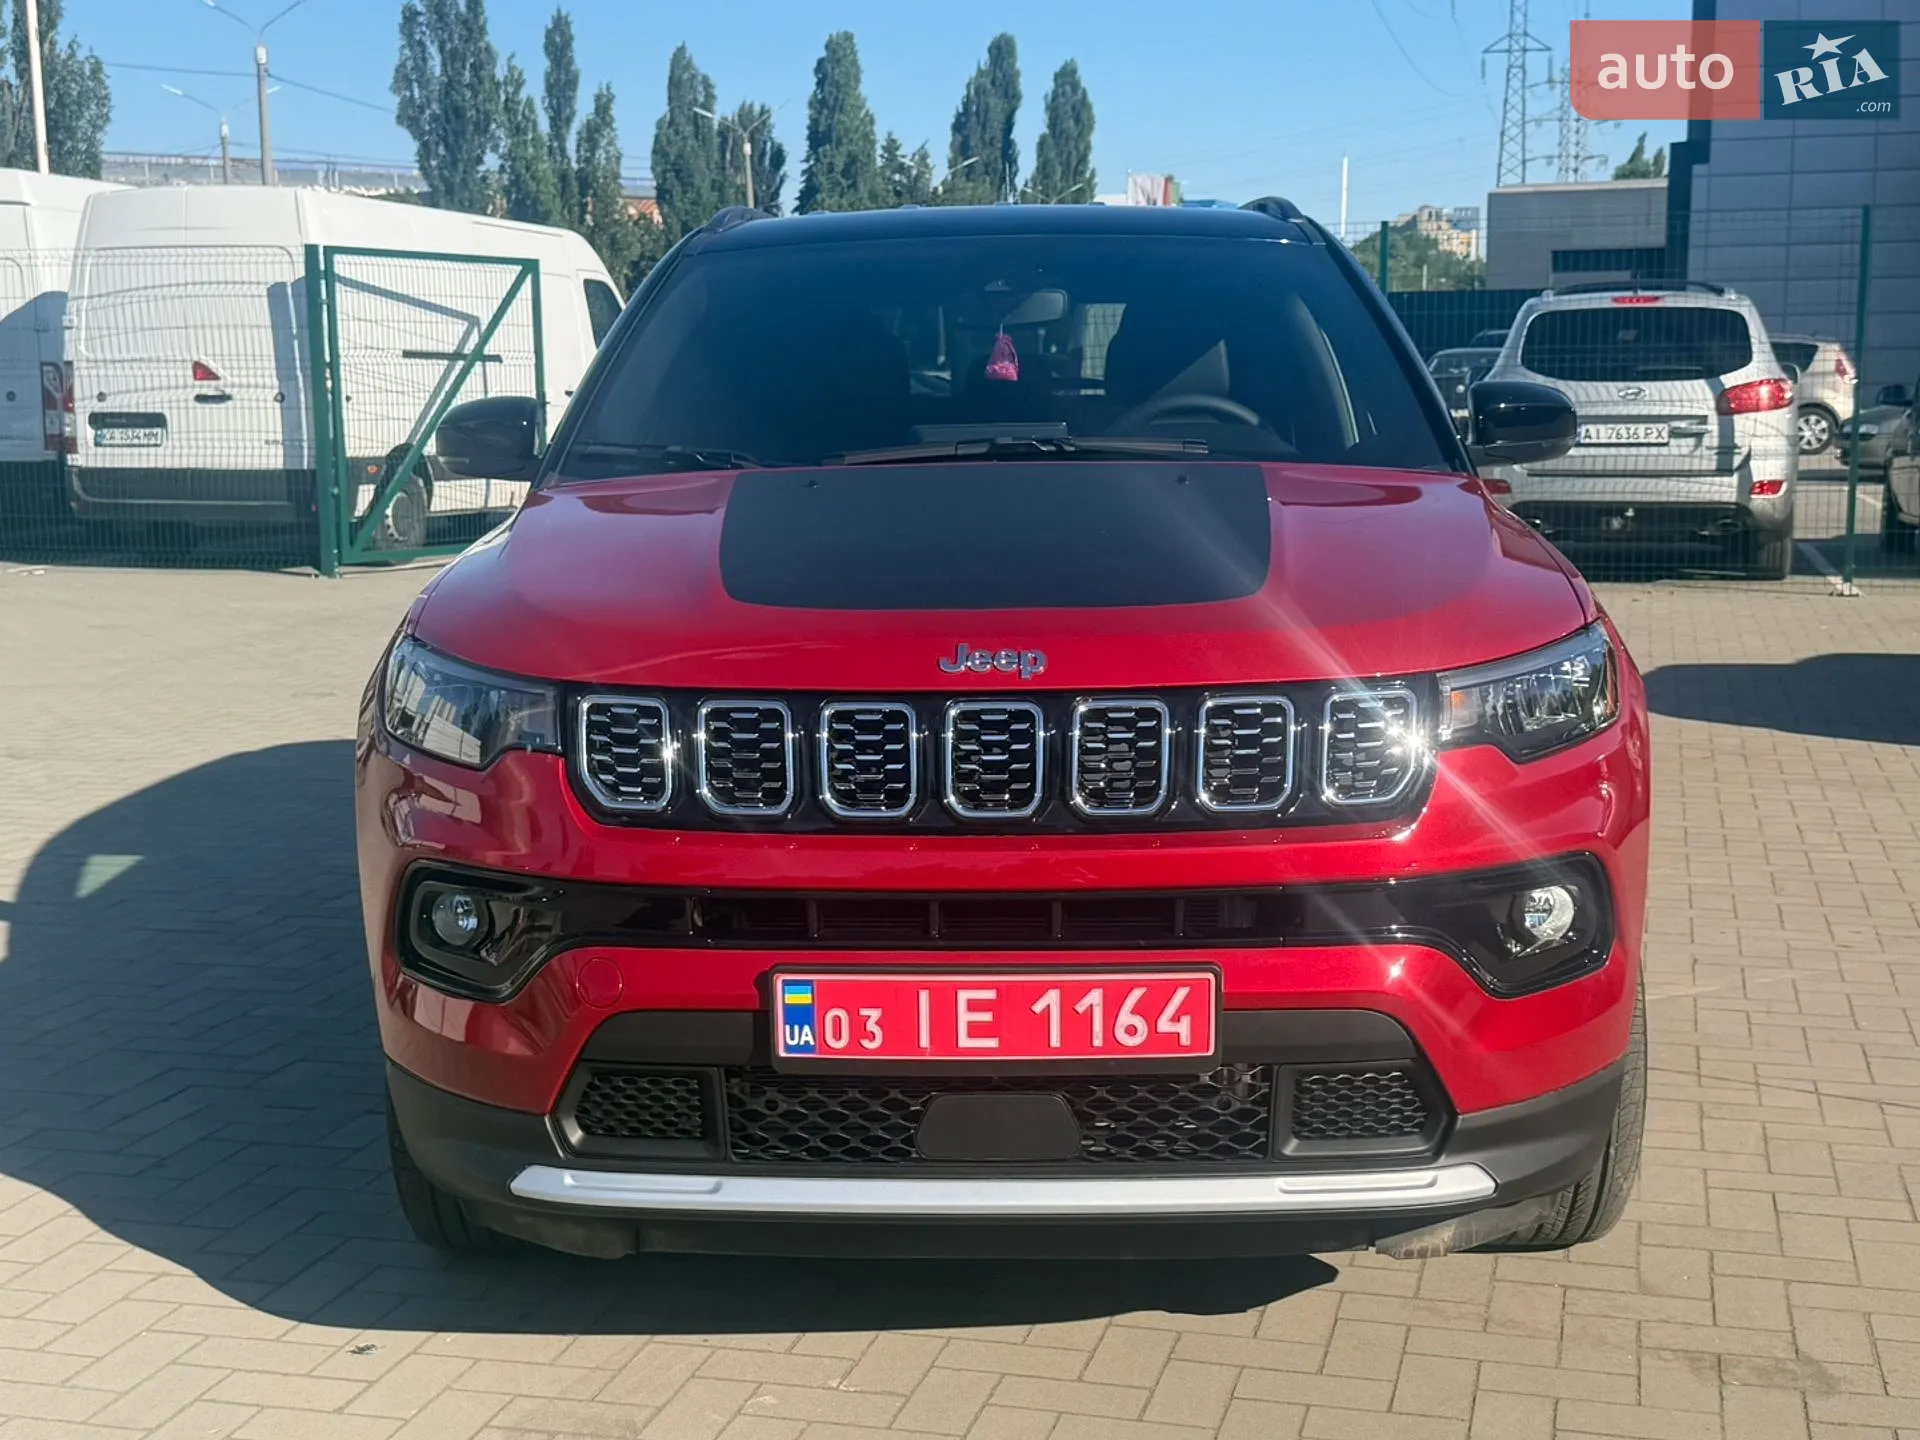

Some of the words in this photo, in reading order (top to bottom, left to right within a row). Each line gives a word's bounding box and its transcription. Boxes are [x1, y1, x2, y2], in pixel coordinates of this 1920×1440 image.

[1583, 428, 1600, 440] AI
[1607, 427, 1640, 440] 7636
[1644, 427, 1666, 440] PX
[939, 642, 1048, 680] Jeep
[823, 1008, 884, 1050] 03
[916, 988, 1000, 1049] IE
[1030, 986, 1192, 1048] 1164
[784, 1025, 815, 1047] UA
